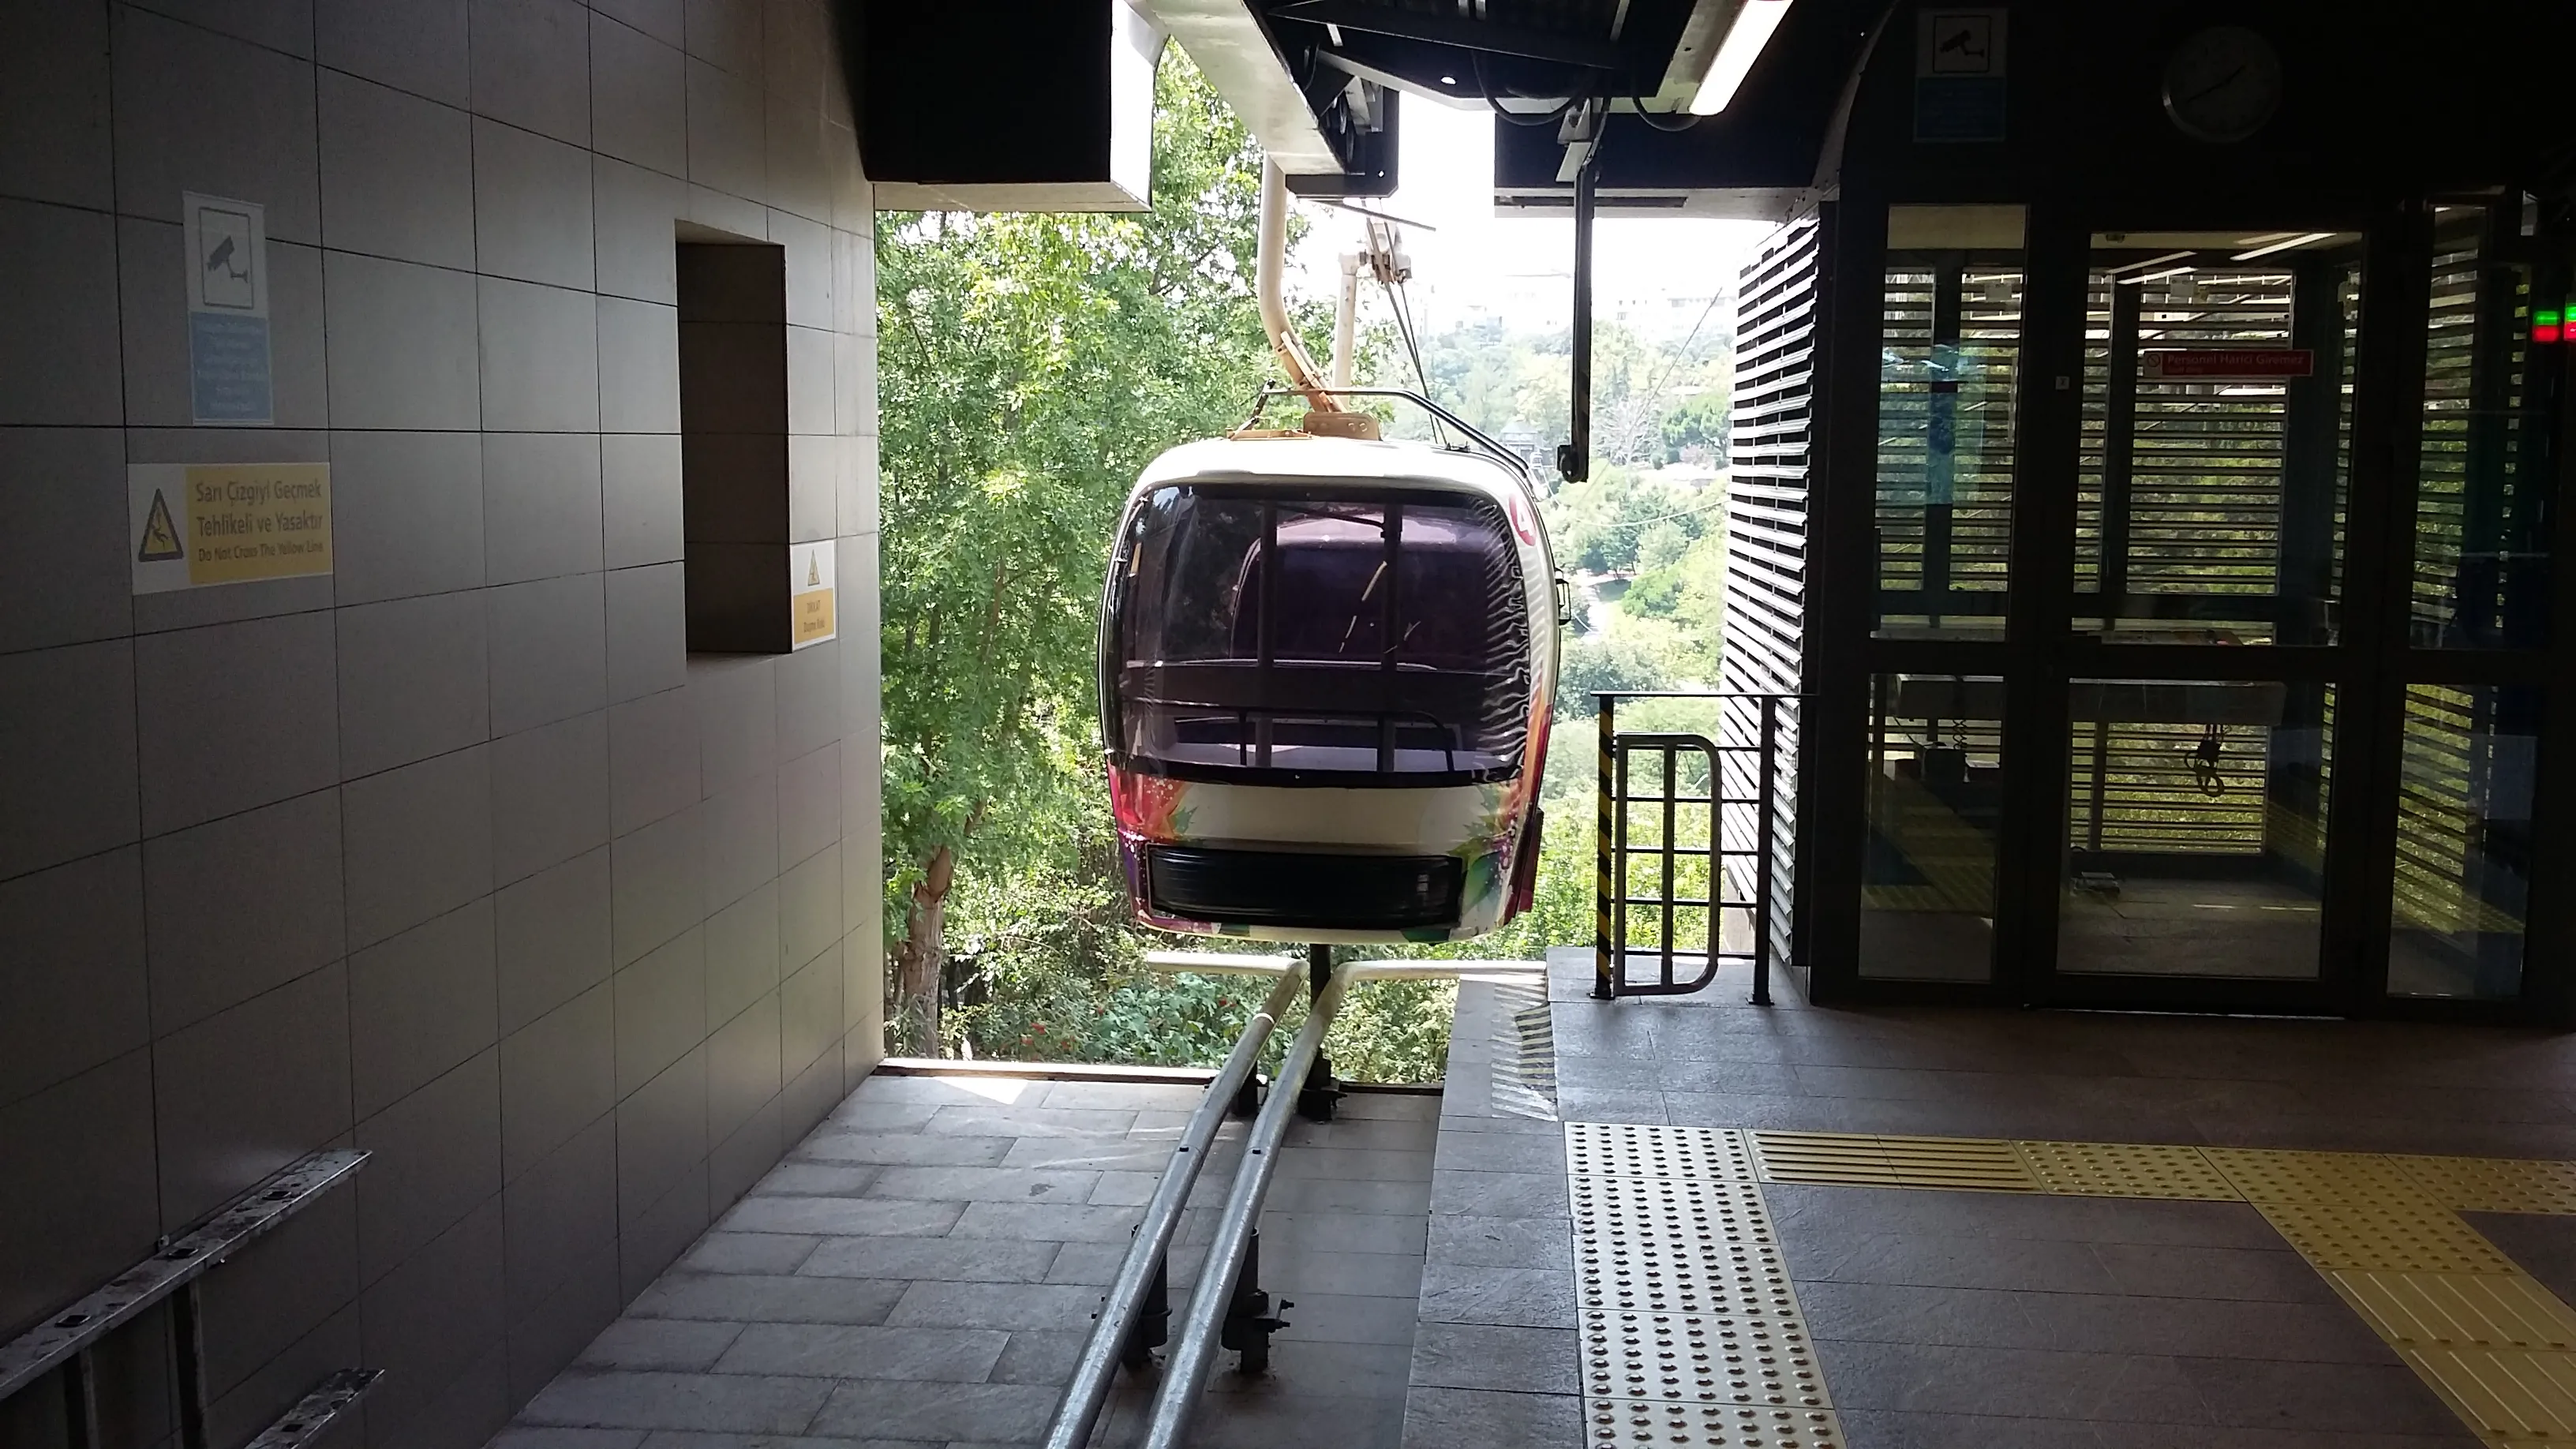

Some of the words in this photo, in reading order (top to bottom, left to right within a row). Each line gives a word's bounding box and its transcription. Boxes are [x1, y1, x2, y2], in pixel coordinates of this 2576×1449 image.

[2168, 354, 2216, 365] Personel
[227, 478, 270, 506] Çizgiyi
[274, 477, 321, 504] Geçmek
[197, 512, 253, 537] Tehlikeli
[257, 516, 271, 533] ve
[199, 548, 212, 562] Do
[214, 547, 231, 560] Not
[234, 545, 258, 559] Cross
[260, 544, 275, 556] The
[276, 541, 304, 555] Yellow
[307, 539, 324, 552] Line
